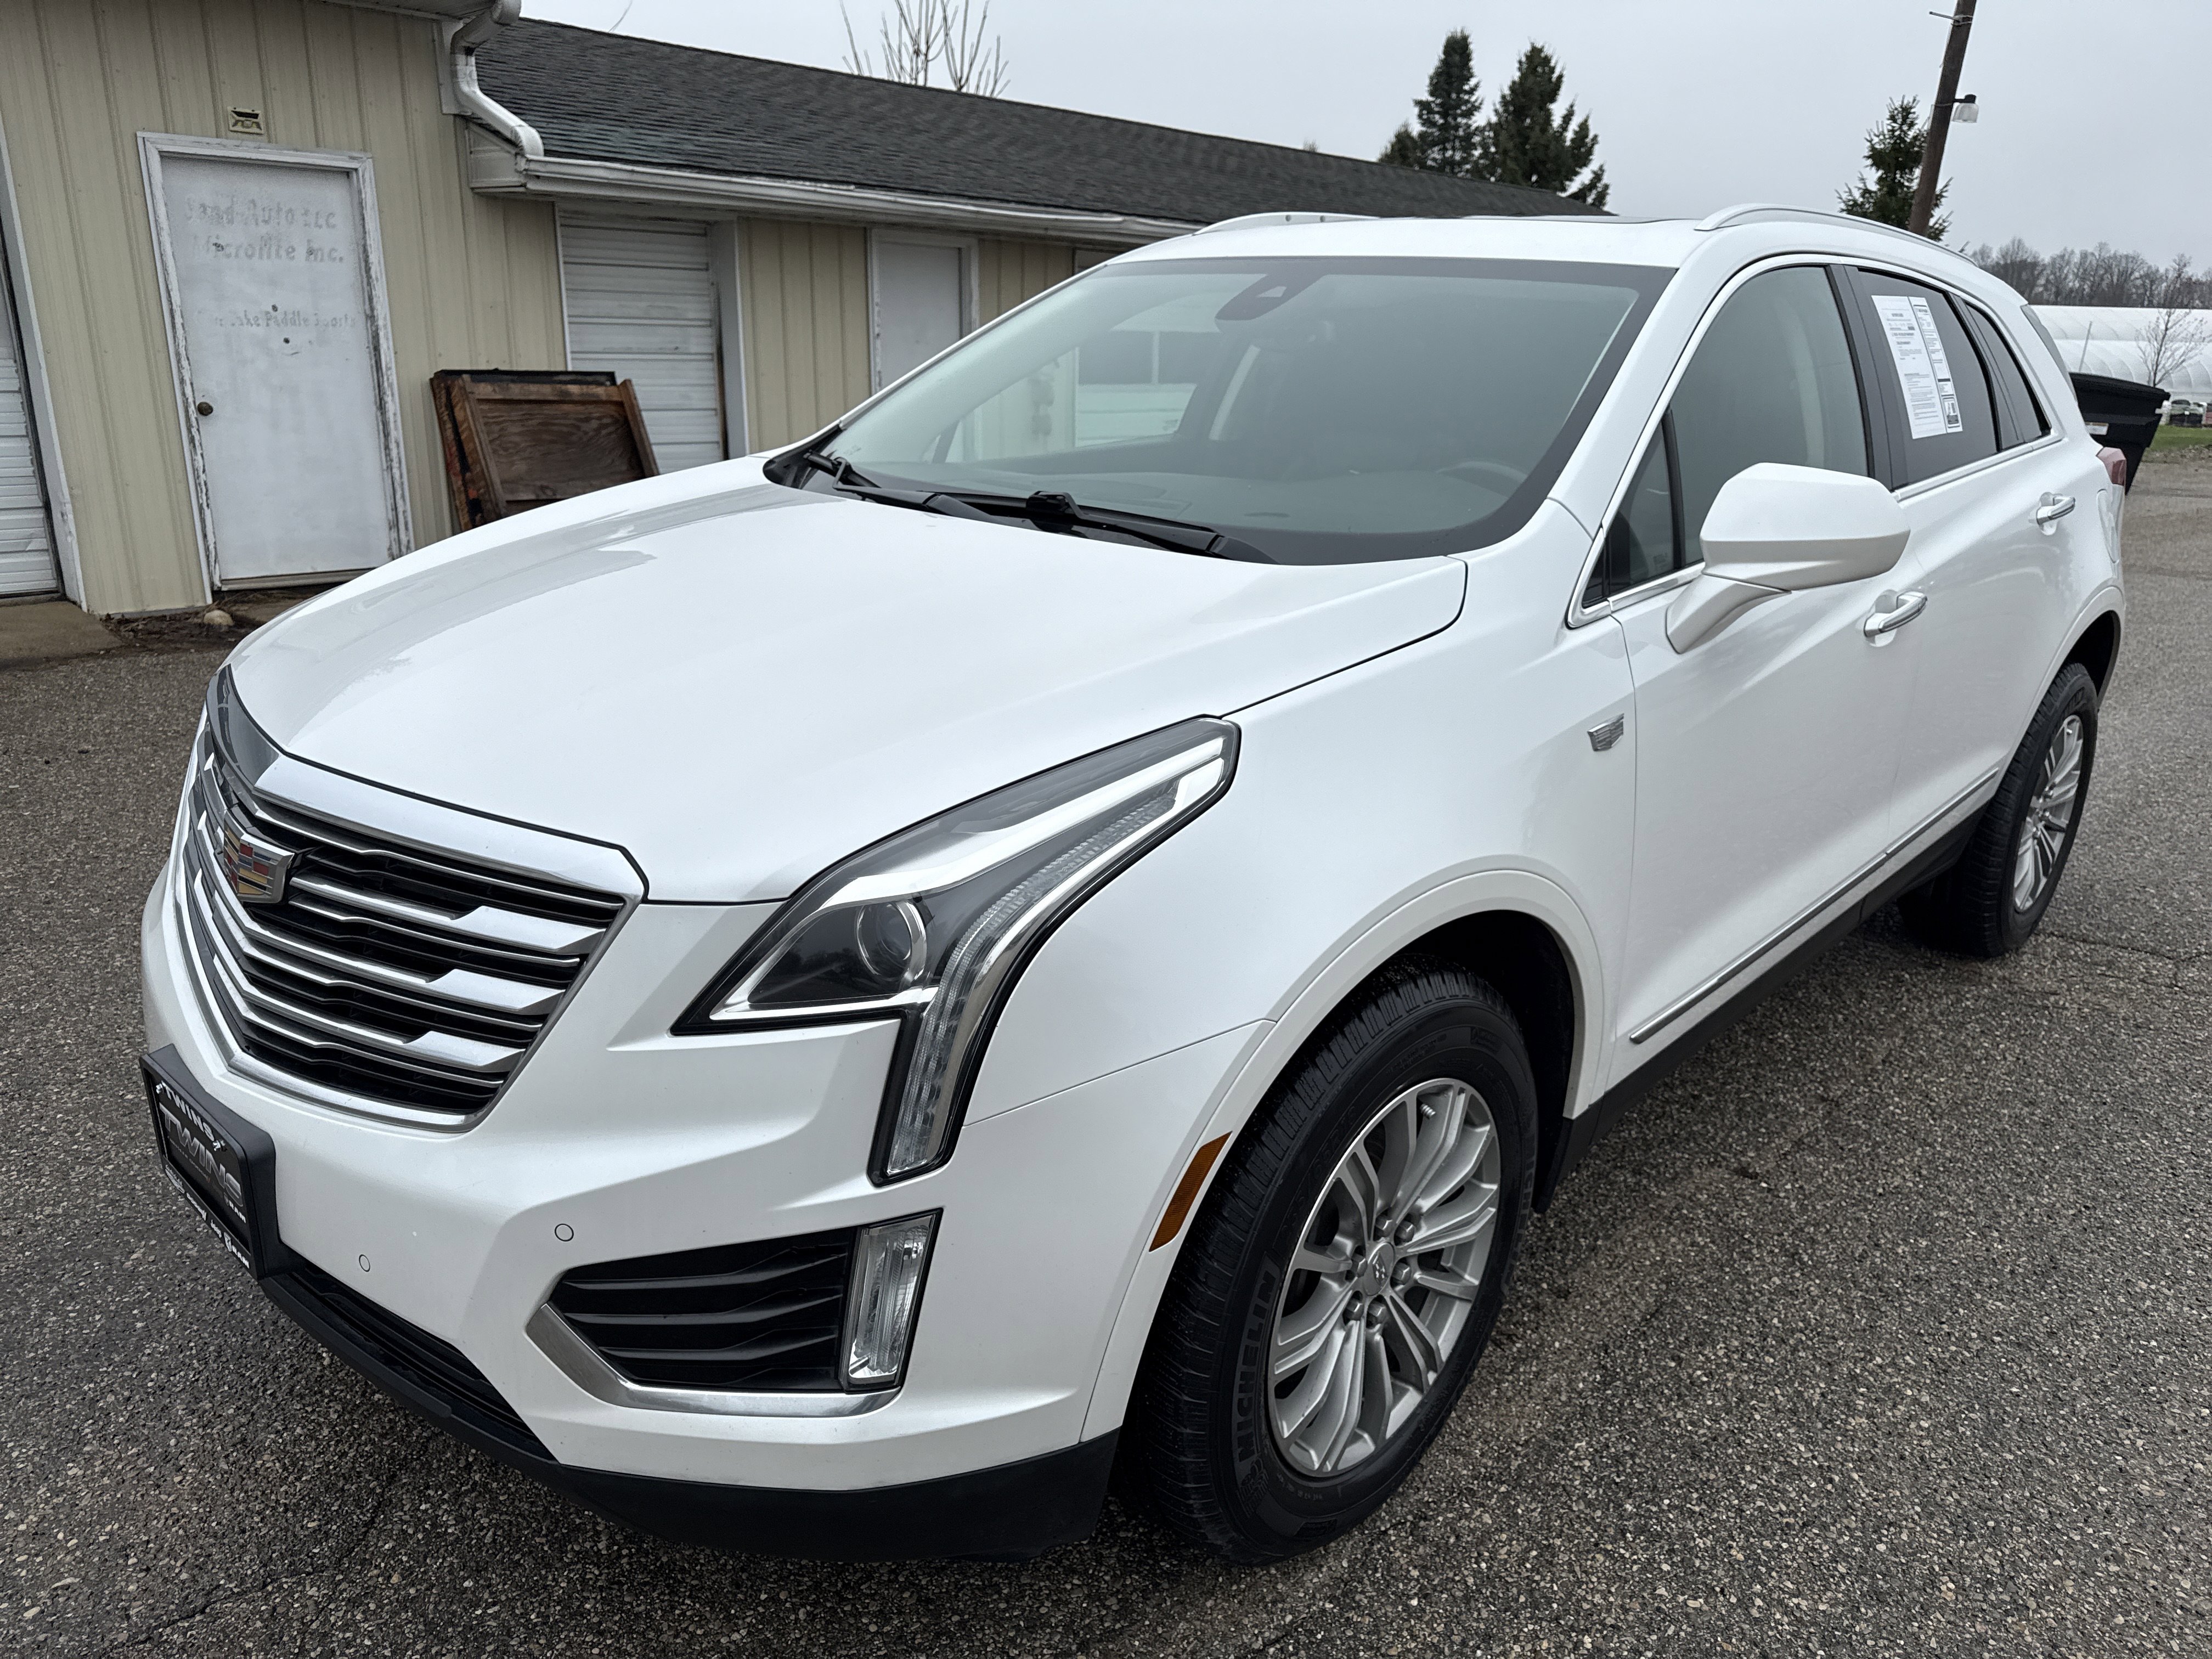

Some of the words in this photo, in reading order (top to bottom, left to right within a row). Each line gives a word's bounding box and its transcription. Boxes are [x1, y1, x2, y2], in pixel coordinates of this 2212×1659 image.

[305, 239, 344, 263] Inc.
[161, 1080, 215, 1142] TWINS
[159, 1102, 244, 1207] TWINS
[229, 1200, 246, 1224] RAM
[232, 1245, 250, 1269] RAM
[1236, 1270, 1279, 1463] MICHELIN
